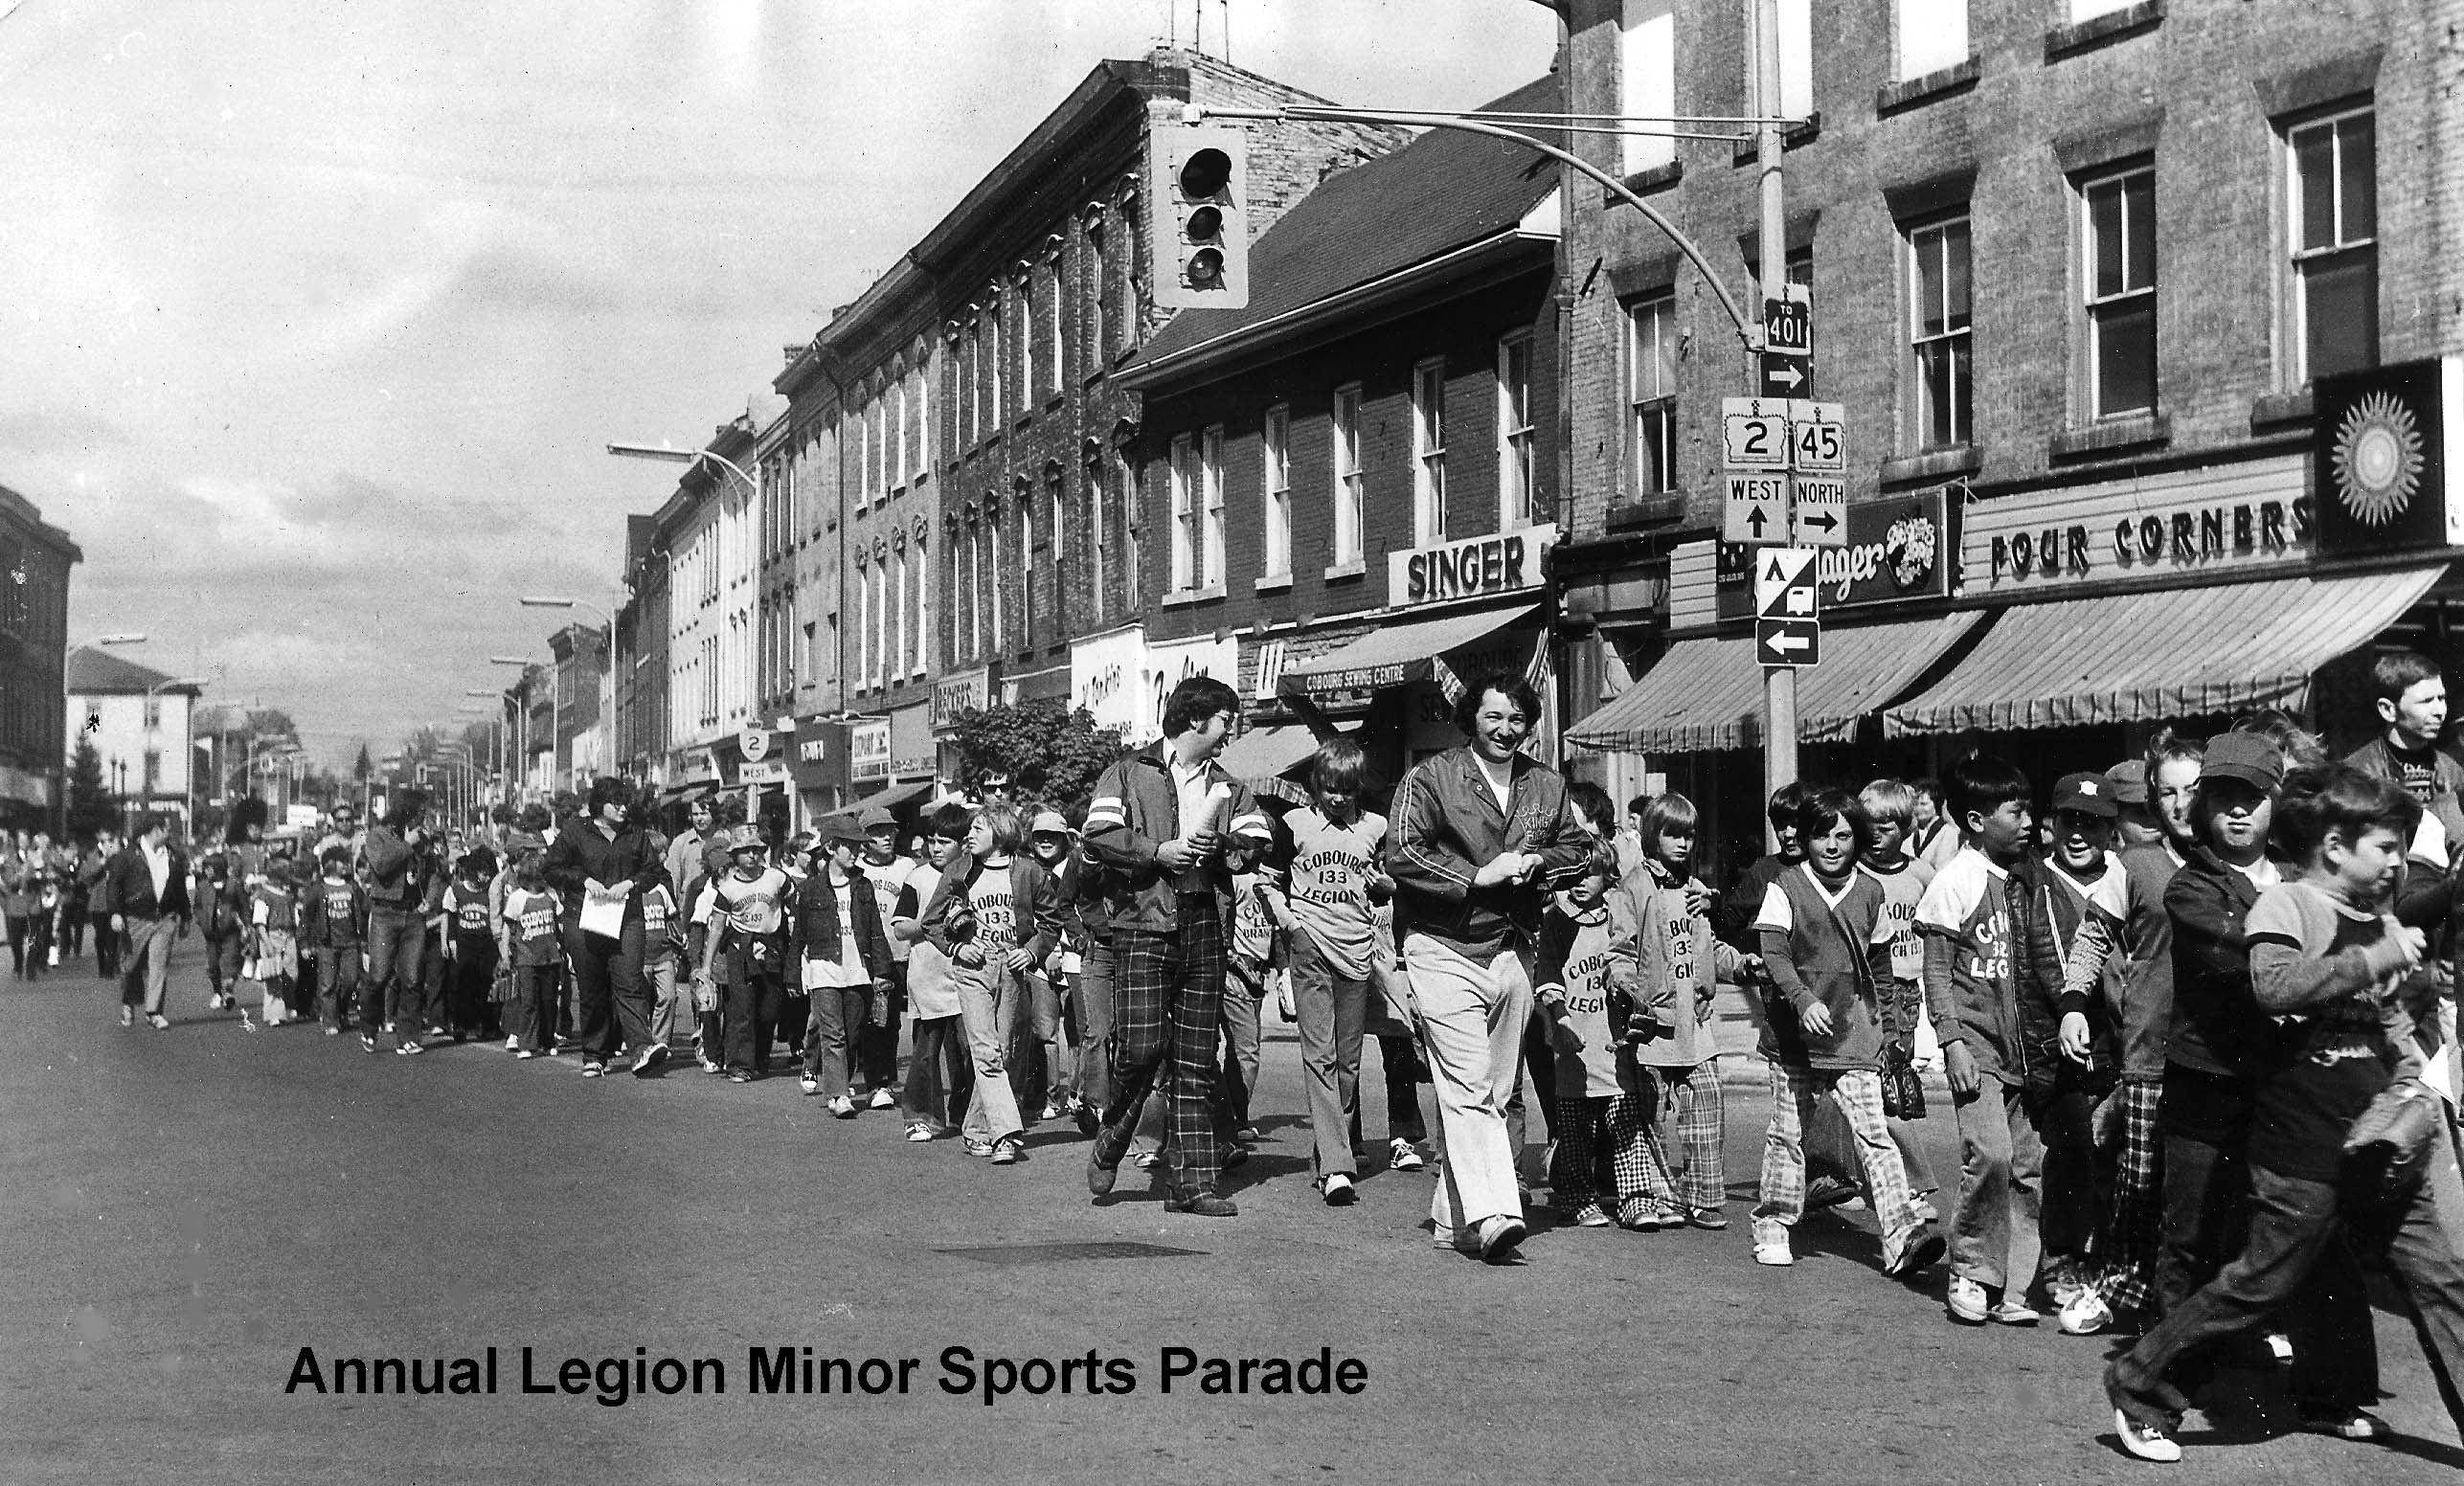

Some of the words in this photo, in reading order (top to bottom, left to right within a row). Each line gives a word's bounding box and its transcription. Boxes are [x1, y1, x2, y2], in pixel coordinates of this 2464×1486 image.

[1780, 304, 1793, 315] TO
[1770, 317, 1801, 343] 401
[1744, 421, 1768, 454] 2
[1800, 427, 1840, 460] 45
[1730, 480, 1781, 501] WEST
[1797, 482, 1844, 505] NORTH
[1990, 525, 2090, 584] FOUR
[2114, 496, 2315, 566] CORNERS
[1407, 536, 1525, 600] SINGER
[1820, 543, 1885, 601] ager
[1306, 670, 1343, 690] COBOURG
[1344, 668, 1371, 687] SEWING
[1374, 664, 1405, 685] CENTRE
[748, 735, 759, 751] 2
[743, 769, 765, 778] WEST
[1524, 816, 1549, 829] KING
[1302, 849, 1364, 875] COBOURG
[1318, 869, 1347, 885] 133
[1301, 887, 1360, 905] LEGION
[985, 911, 1010, 924] 133
[980, 926, 1017, 943] EGIO
[1569, 953, 1605, 979] COBO
[1970, 957, 2009, 979] LEG
[1569, 996, 1604, 1013] LEGI
